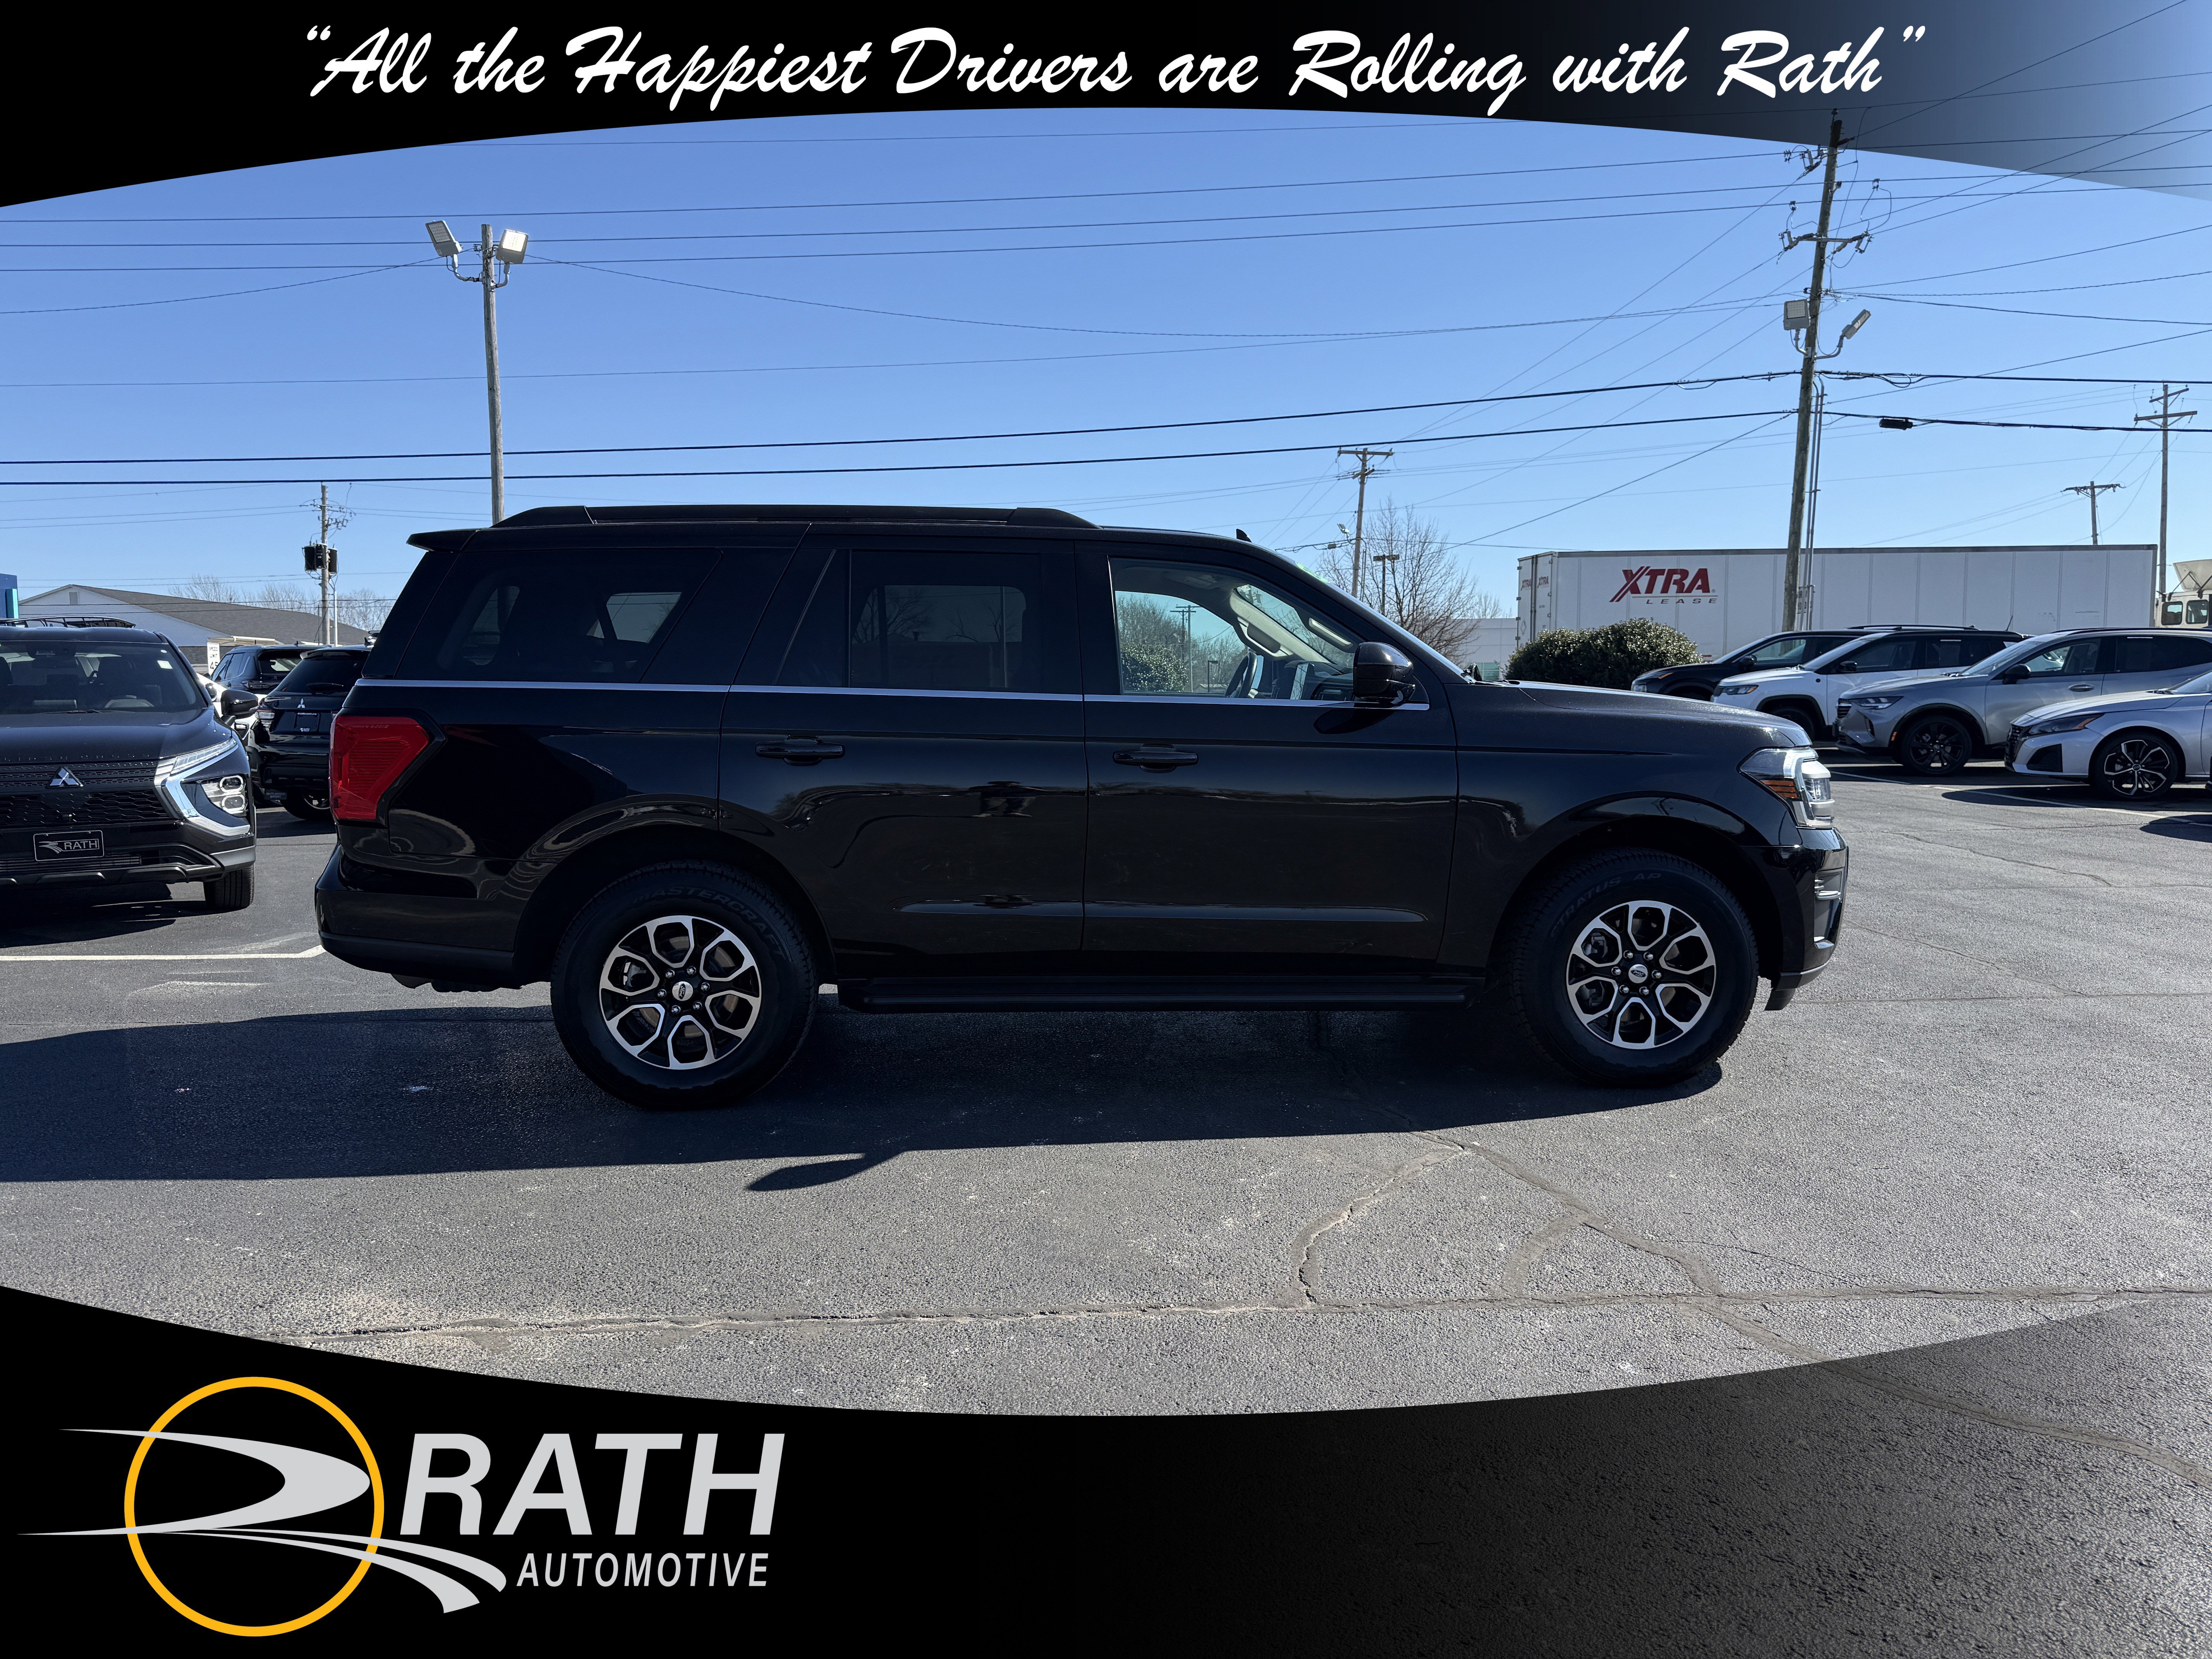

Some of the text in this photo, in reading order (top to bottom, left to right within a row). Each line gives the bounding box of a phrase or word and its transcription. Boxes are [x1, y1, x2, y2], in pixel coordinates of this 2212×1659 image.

[1609, 566, 1711, 603] XTRA
[64, 840, 98, 850] RATH
[1632, 872, 1662, 881] AP
